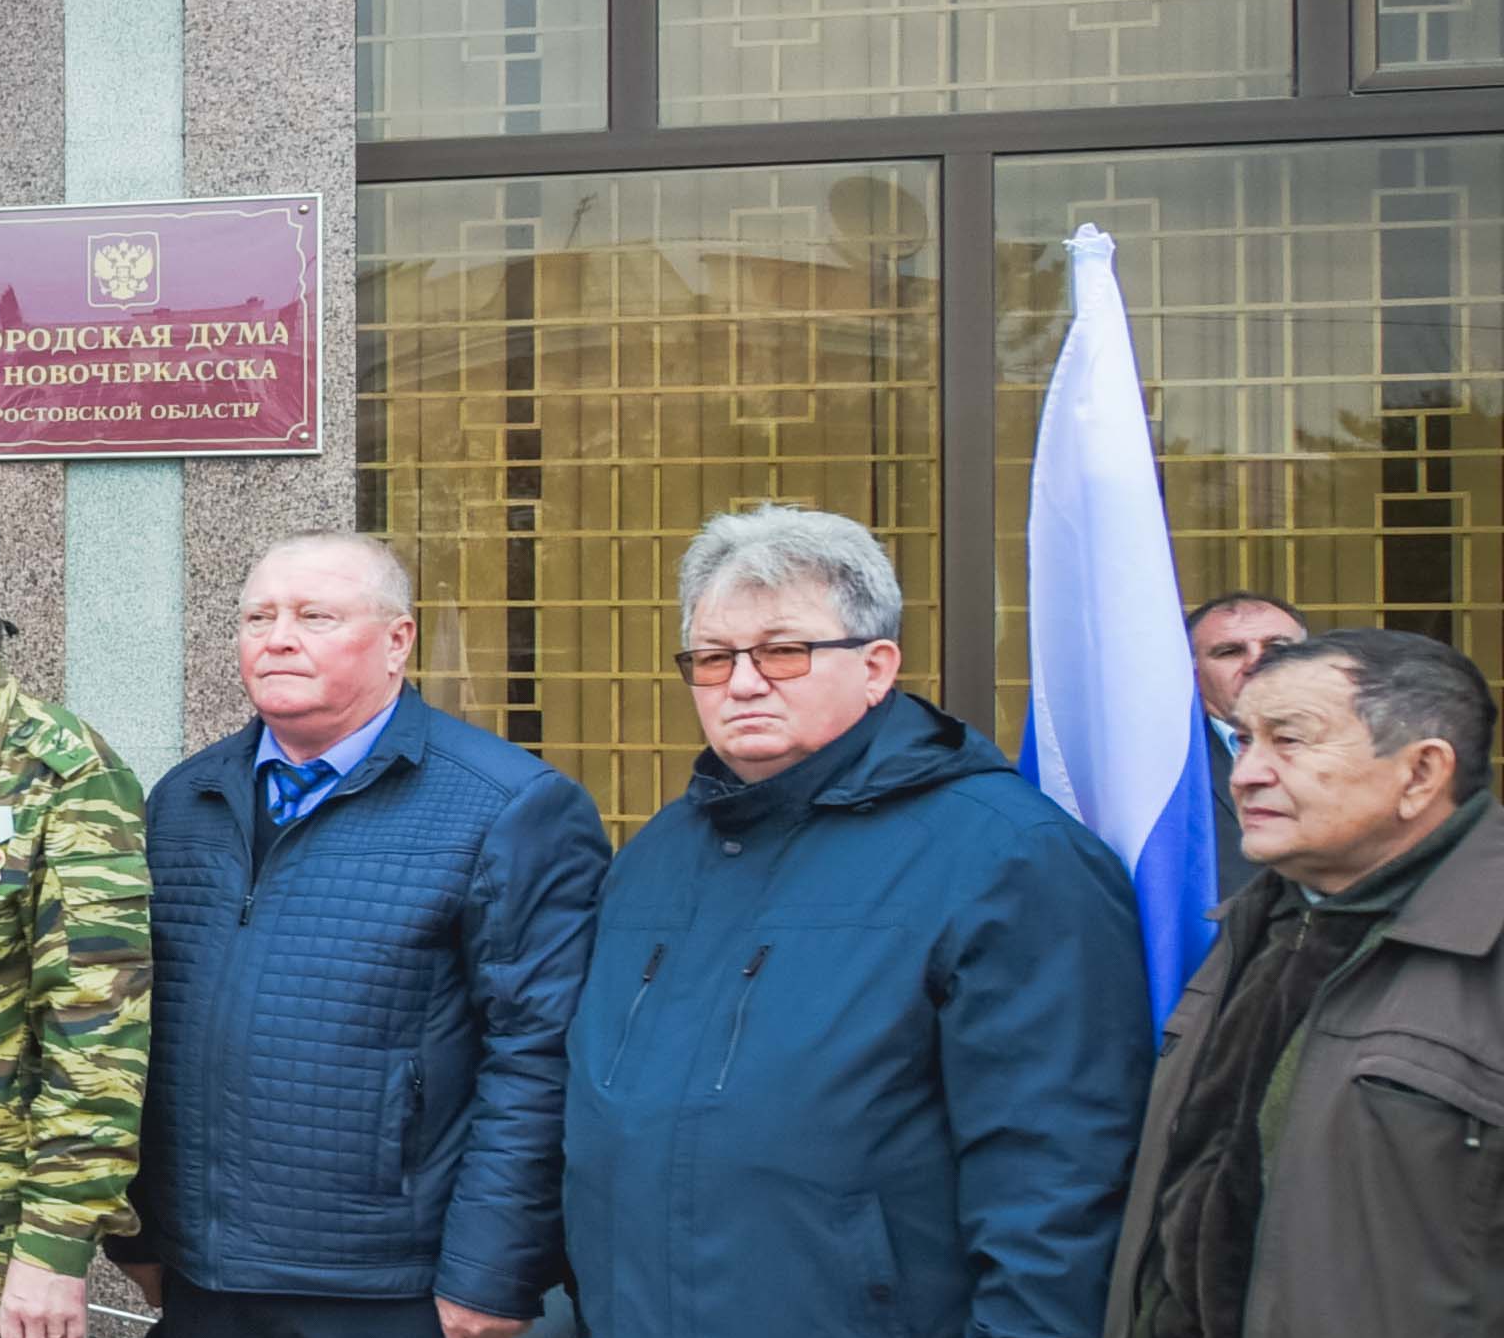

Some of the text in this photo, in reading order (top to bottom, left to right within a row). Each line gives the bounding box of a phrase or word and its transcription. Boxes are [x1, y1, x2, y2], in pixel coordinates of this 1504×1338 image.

[185, 320, 290, 353] ДУМА
[4, 357, 279, 388] НОВОЧЕРКАССКА
[150, 400, 261, 421] ОБЛАСТИ
